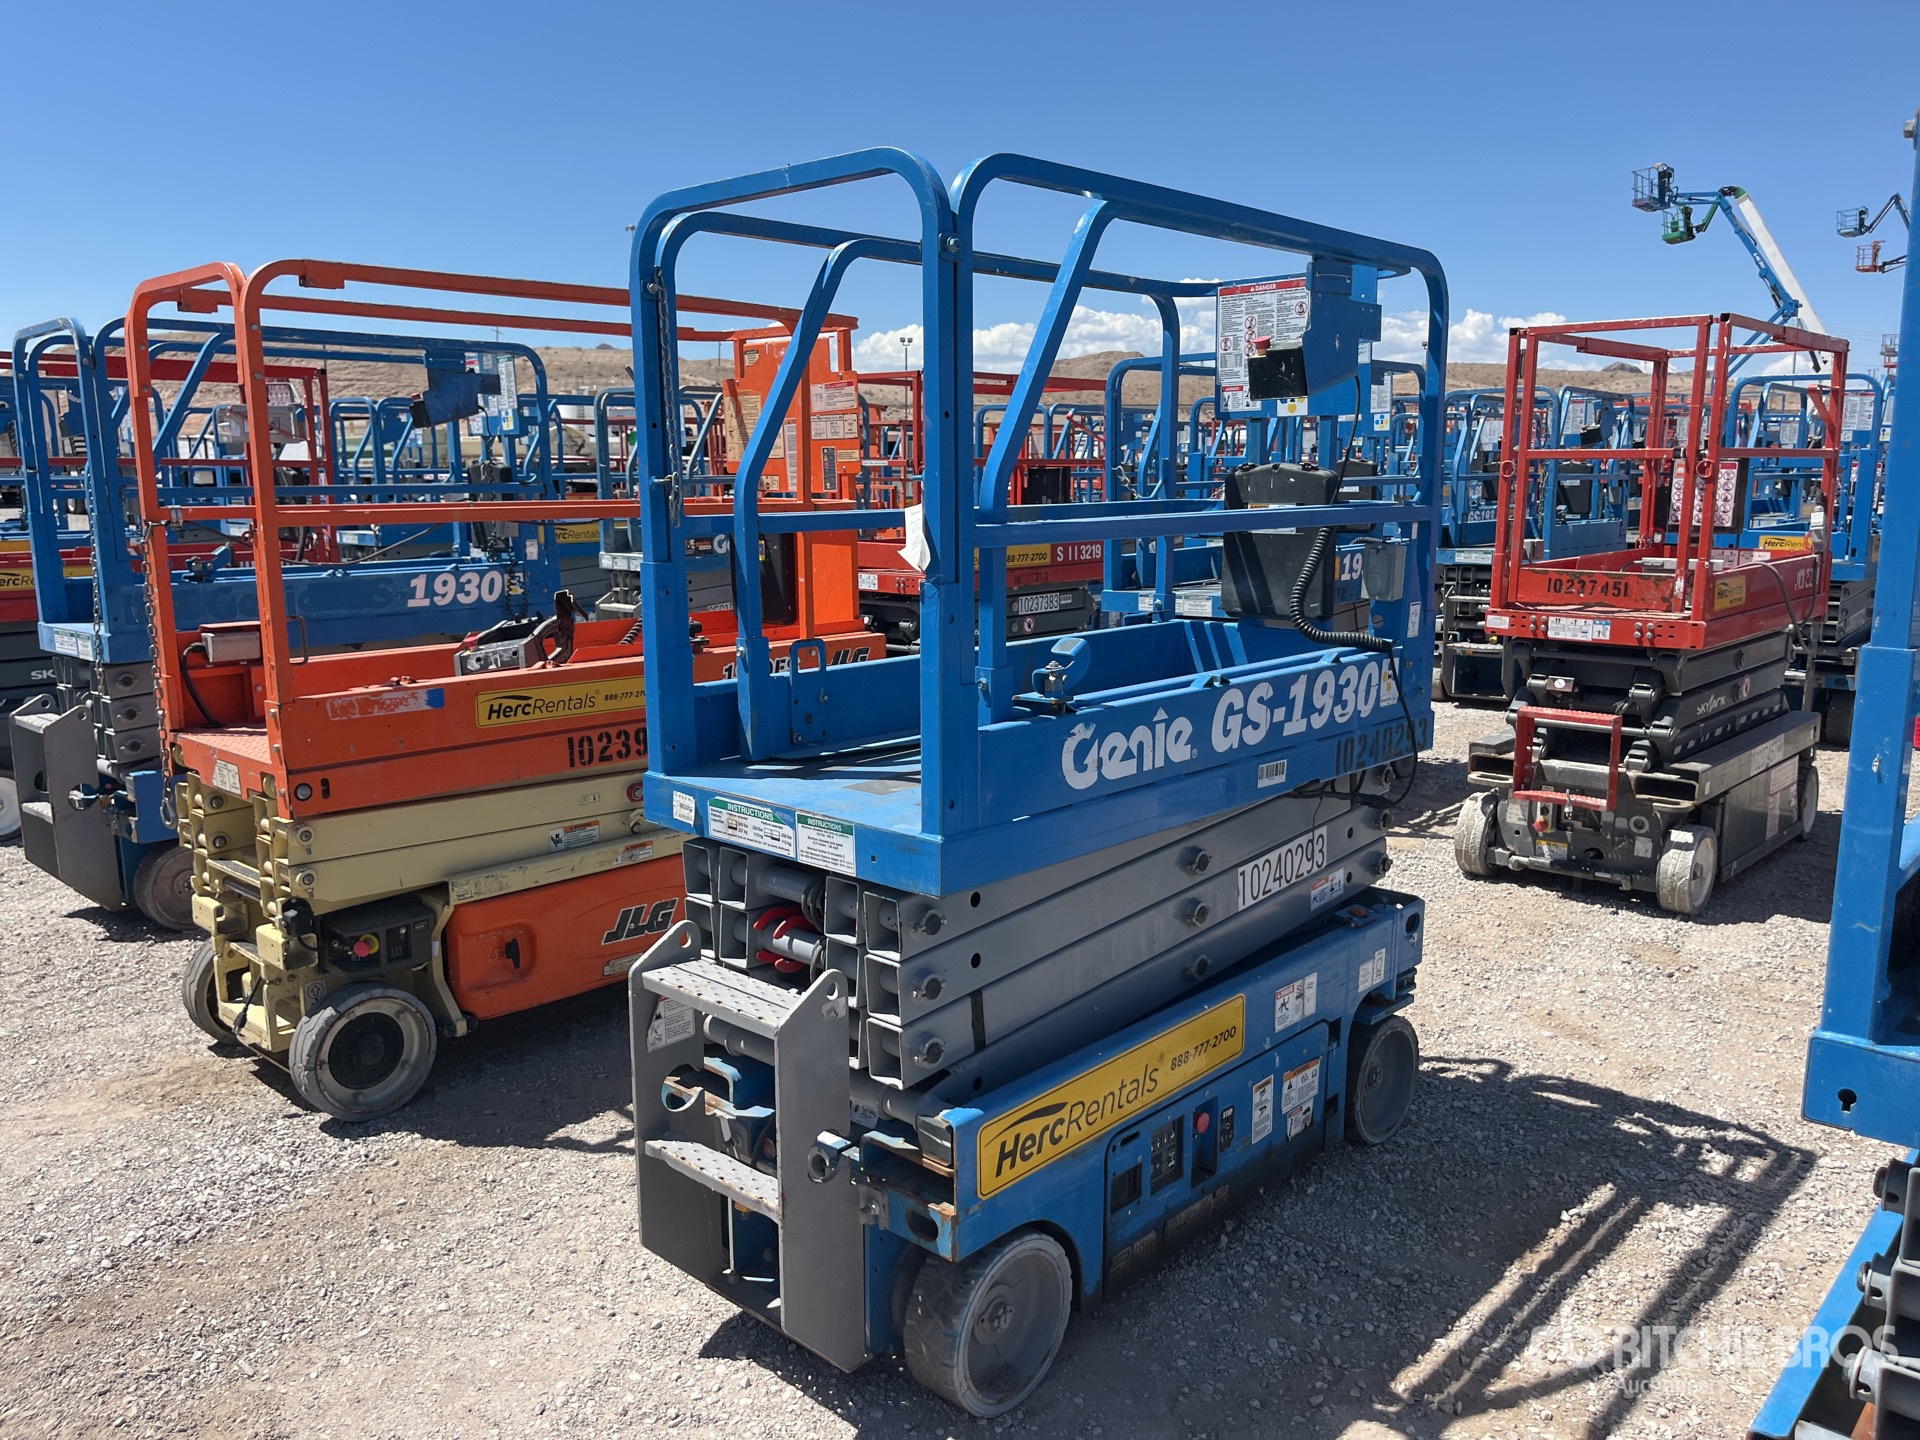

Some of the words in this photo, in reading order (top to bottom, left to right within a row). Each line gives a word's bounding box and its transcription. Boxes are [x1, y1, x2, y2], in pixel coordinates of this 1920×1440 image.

[1006, 552, 1048, 563] 88-777-2700
[1340, 553, 1363, 581] 19
[407, 570, 503, 608] 1930
[1547, 577, 1631, 598] 10237451
[487, 692, 596, 721] HercRentals
[603, 689, 647, 702] 888-777-27
[1062, 706, 1193, 790] Genie
[1211, 661, 1379, 753] GS-1930
[566, 727, 648, 769] 10239
[728, 802, 774, 821] INSTRUCTIONS
[808, 817, 843, 832] INSTRUCTIONS
[1240, 834, 1325, 906] 10240293
[601, 898, 679, 945] JLG
[1170, 1025, 1237, 1072] 888-777-2700
[995, 1064, 1160, 1179] HercRentals
